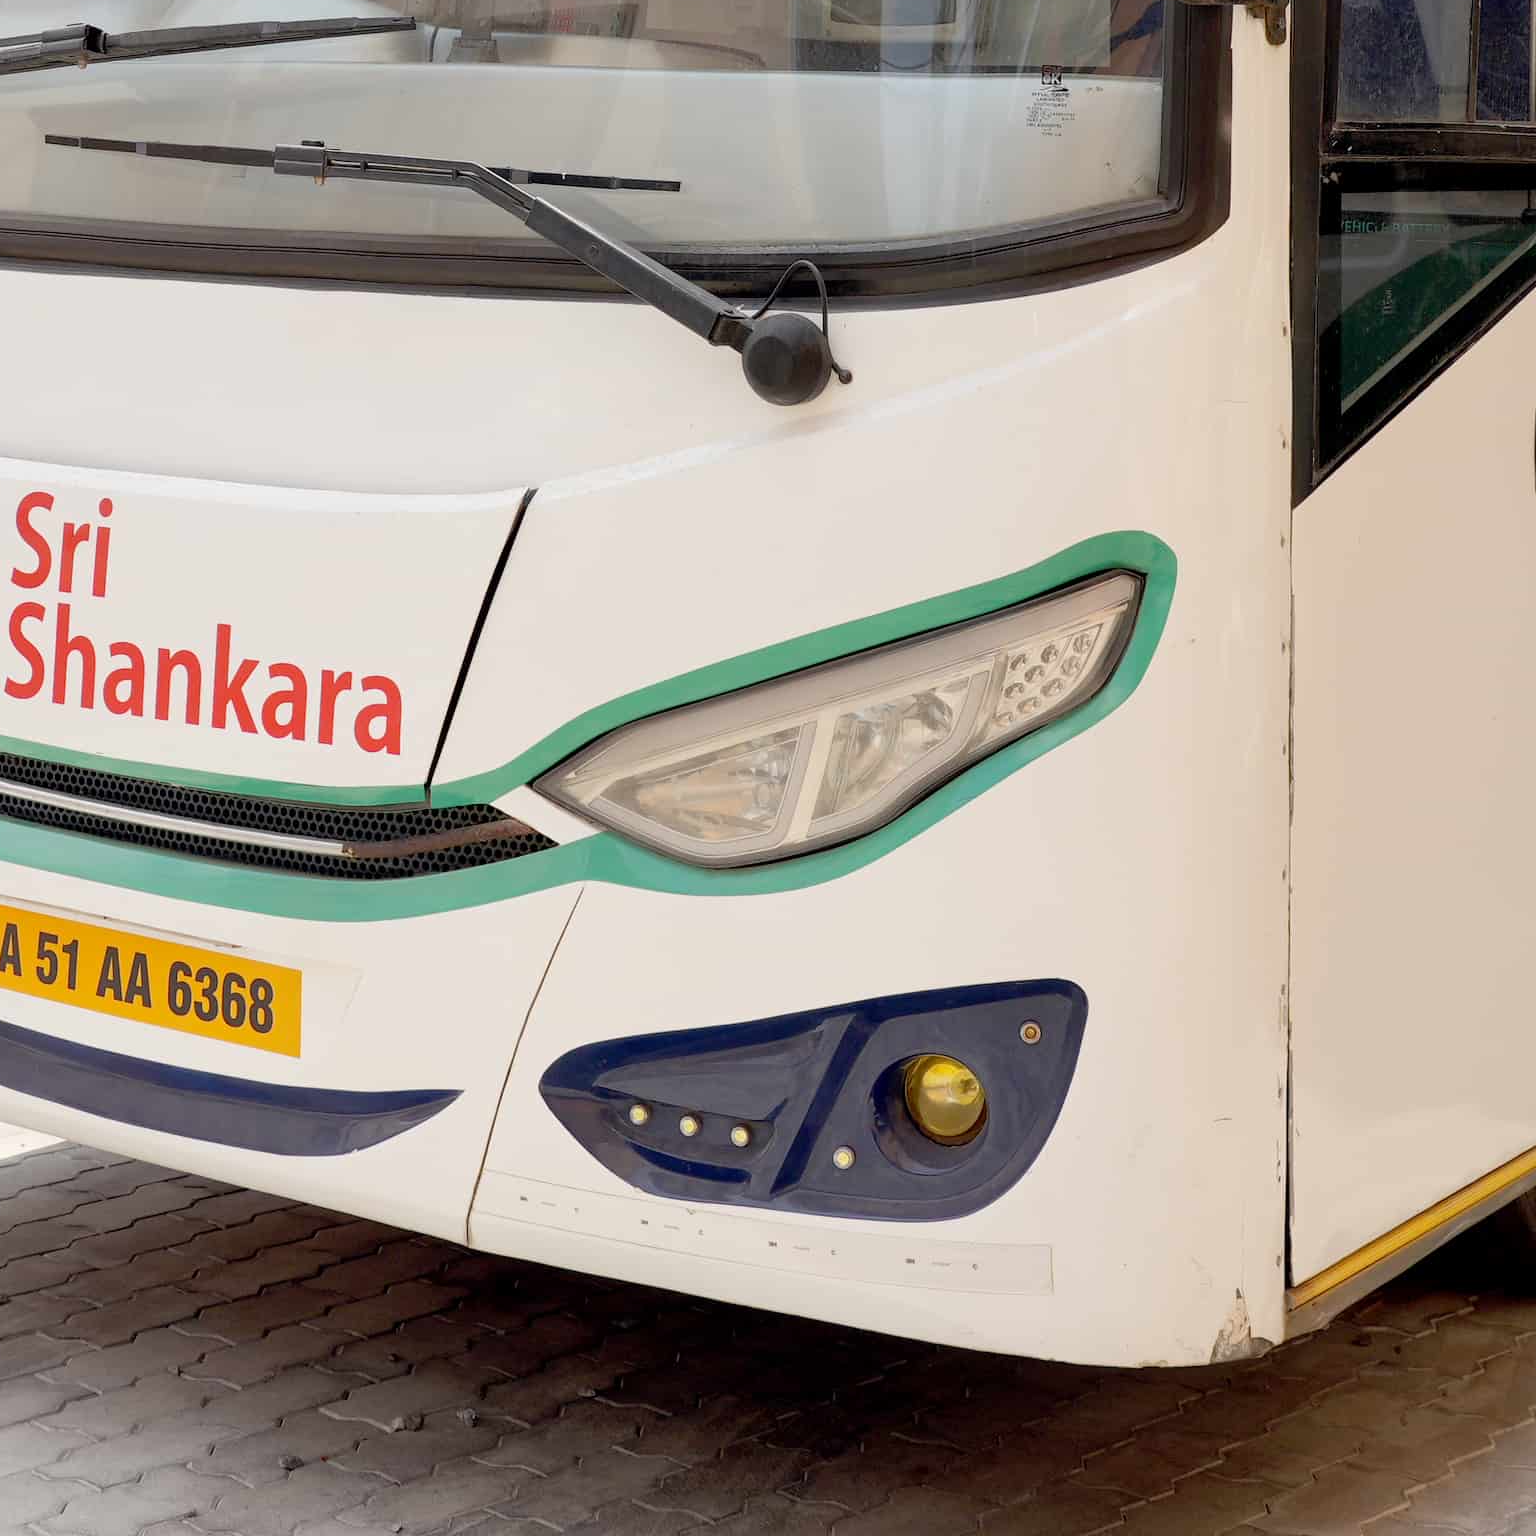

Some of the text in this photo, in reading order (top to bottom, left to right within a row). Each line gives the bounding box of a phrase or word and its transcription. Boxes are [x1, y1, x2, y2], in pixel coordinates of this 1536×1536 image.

[11, 490, 113, 597] Sri
[3, 601, 402, 755] Shankara
[36, 932, 79, 990] 51
[96, 946, 152, 1008] AA
[167, 961, 274, 1034] 6368
